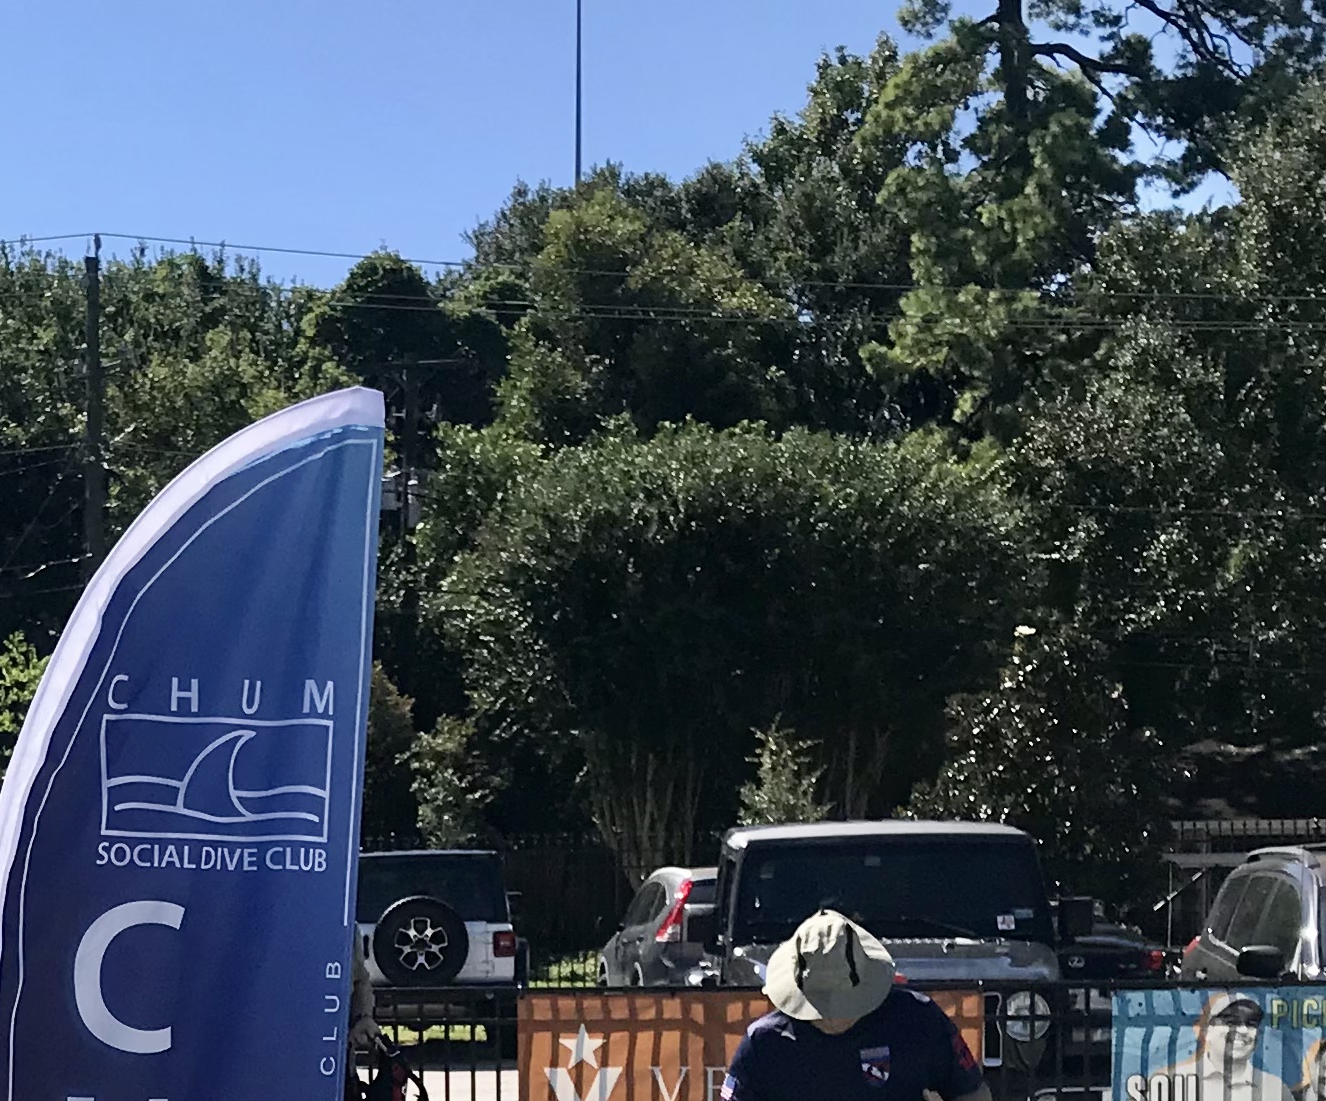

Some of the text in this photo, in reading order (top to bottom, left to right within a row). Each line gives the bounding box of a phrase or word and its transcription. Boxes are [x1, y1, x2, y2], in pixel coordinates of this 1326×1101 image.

[107, 674, 334, 716] CHUM
[95, 841, 328, 873] SOCIAL DIVE CLUB
[319, 960, 343, 1076] CLUB
[1272, 999, 1326, 1028] PIC
